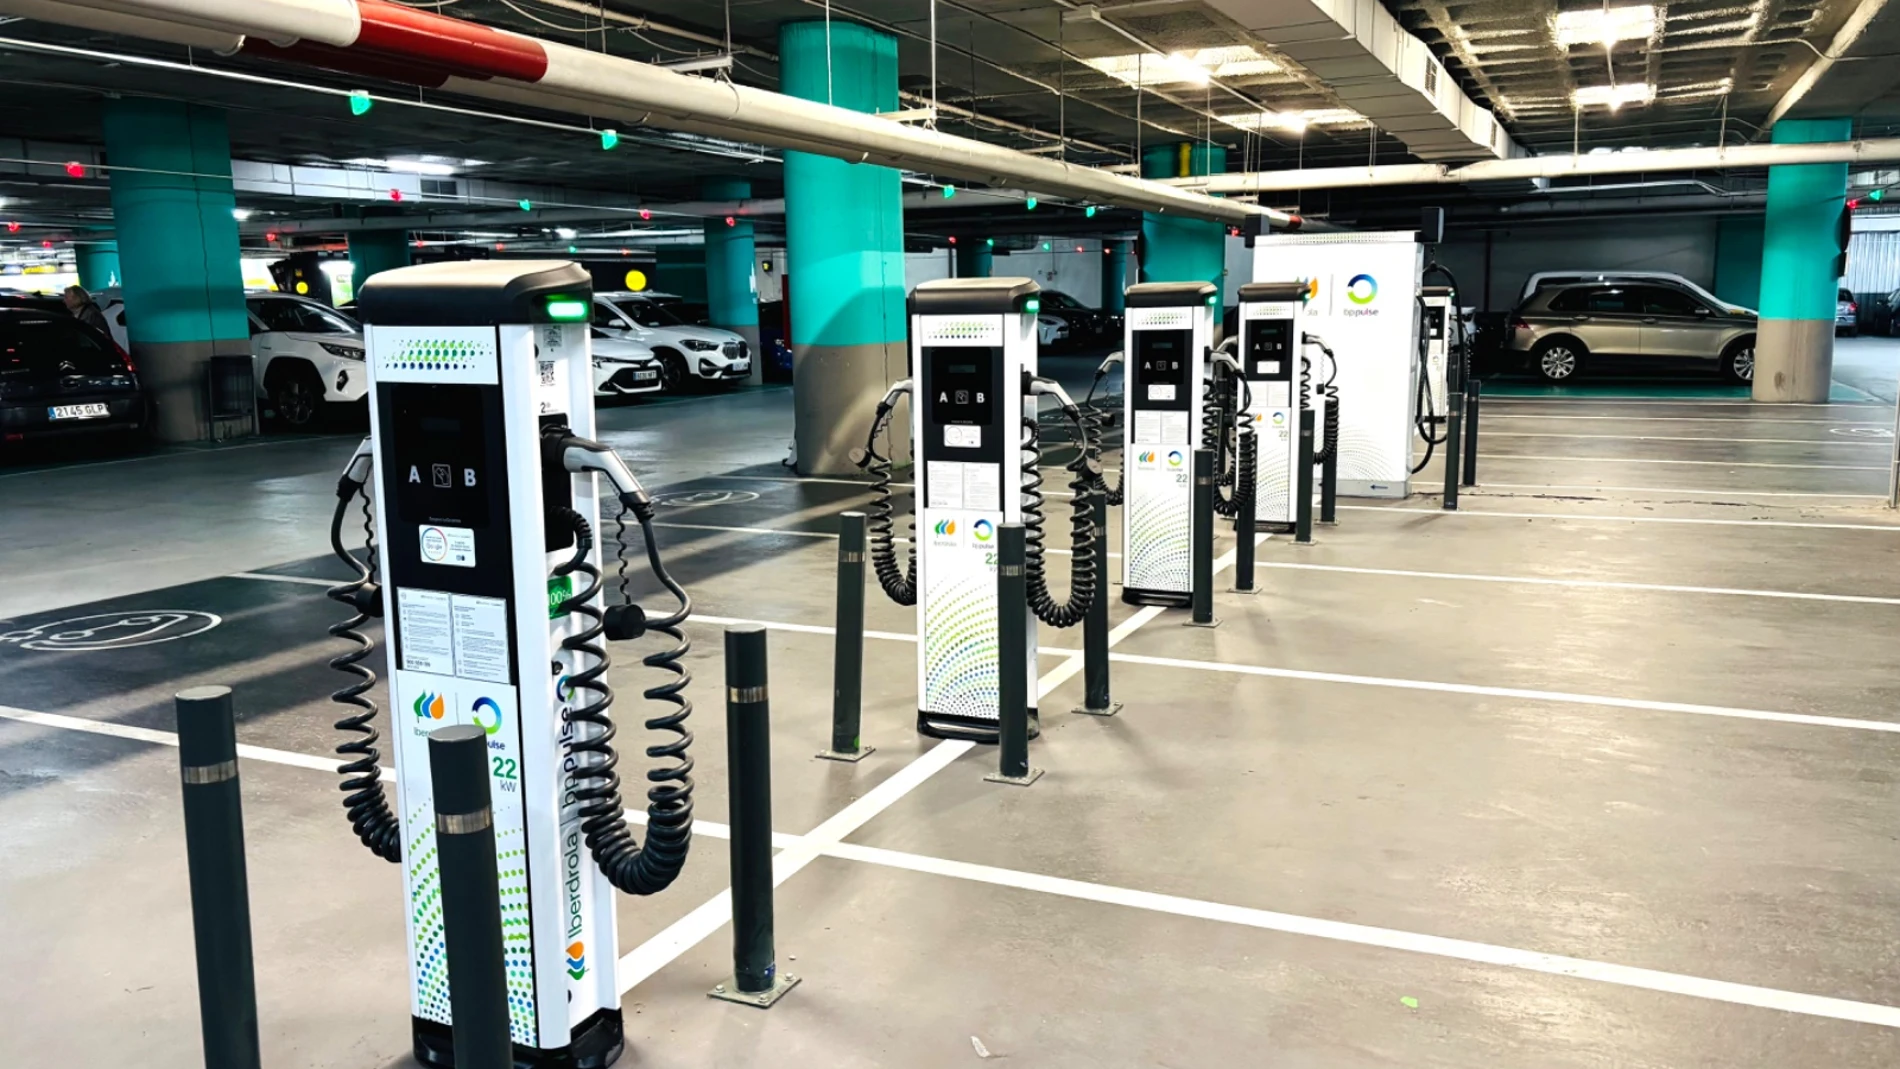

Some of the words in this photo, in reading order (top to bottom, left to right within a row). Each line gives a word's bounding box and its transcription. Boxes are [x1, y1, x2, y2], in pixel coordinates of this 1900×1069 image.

[1144, 361, 1151, 370] A
[1172, 361, 1179, 370] B
[939, 391, 948, 403] A
[976, 392, 985, 403] B
[56, 405, 83, 418] 2145
[84, 404, 104, 415] GLP
[408, 465, 421, 483] A
[464, 468, 477, 487] B
[1175, 473, 1188, 483] 22
[492, 756, 518, 780] 22
[500, 780, 517, 793] kW
[565, 832, 583, 938] Iberdrola
